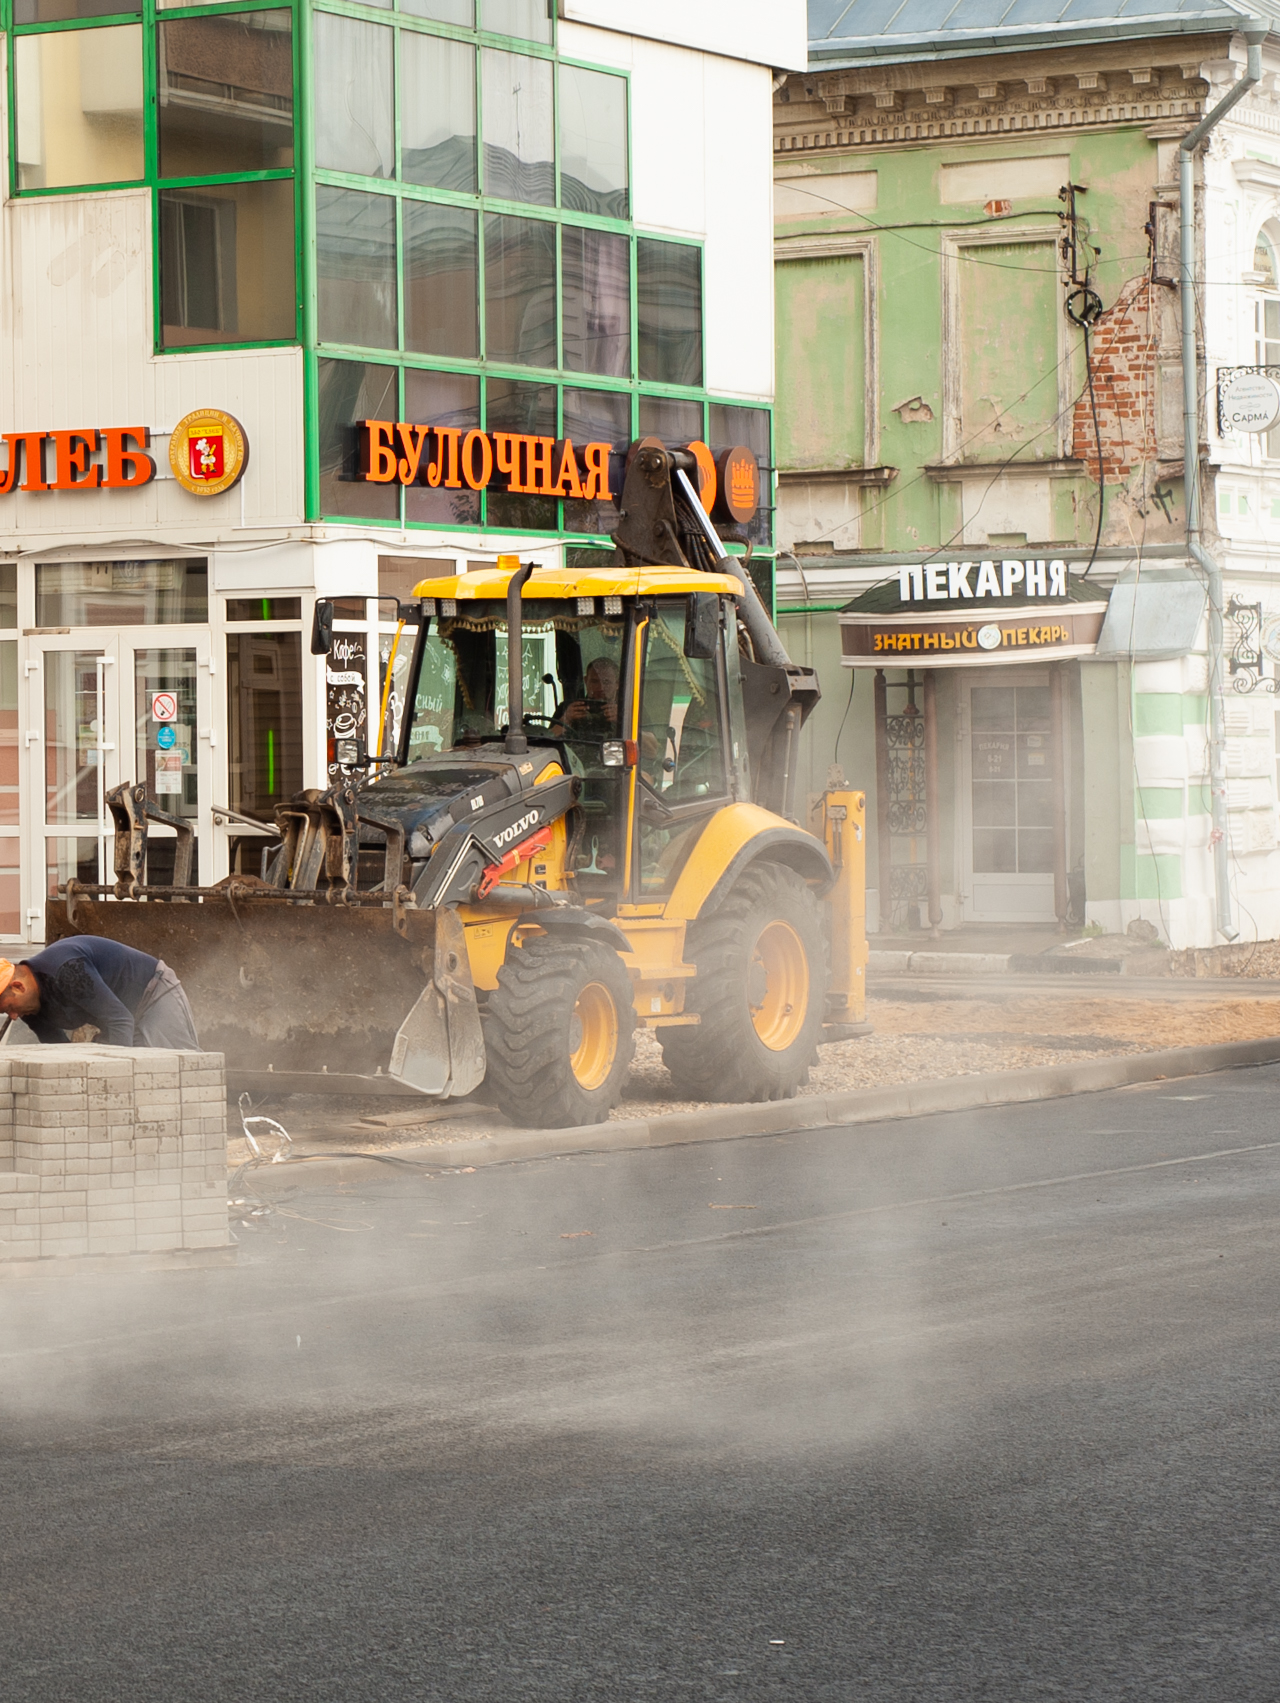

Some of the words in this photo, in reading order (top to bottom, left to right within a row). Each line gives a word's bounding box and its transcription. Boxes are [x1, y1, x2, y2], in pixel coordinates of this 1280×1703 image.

[357, 419, 612, 501] БУЛОЧНАЯ
[899, 560, 1067, 601] ПЕКАРНЯ
[333, 639, 355, 669] Кофе
[873, 626, 978, 651] ЗНАТНЫЙ
[1002, 624, 1069, 646] ПЕКАРЬ
[979, 742, 1010, 751] ПЕКАРНЯ
[492, 809, 539, 849] VOLVO
